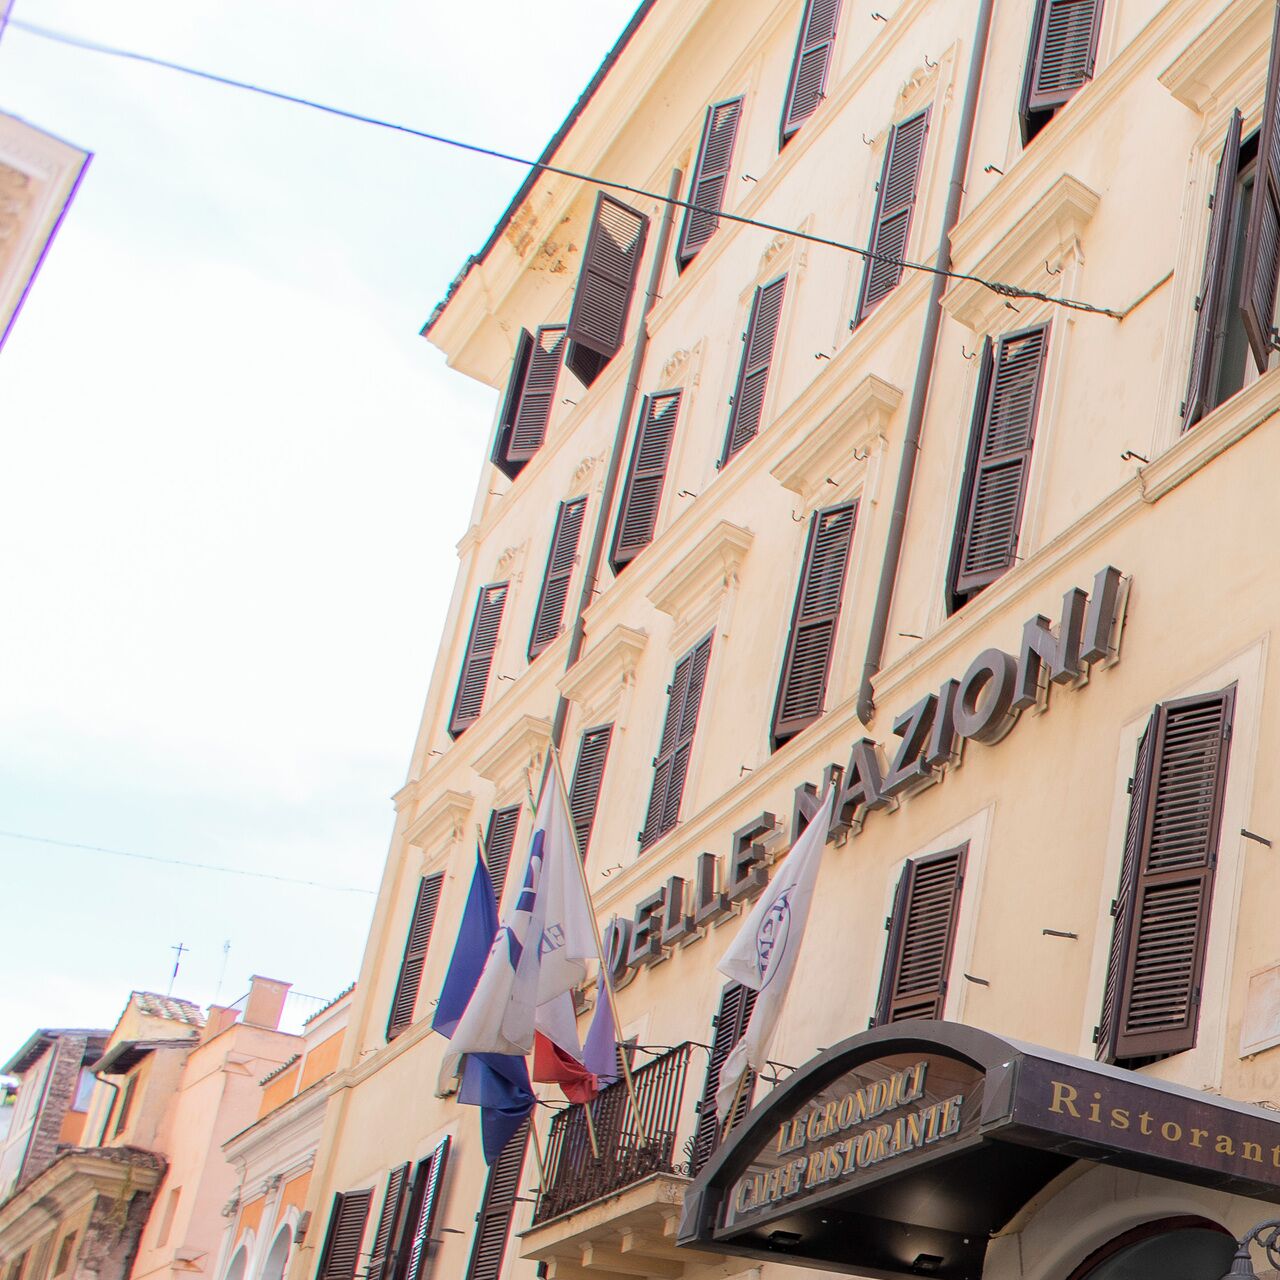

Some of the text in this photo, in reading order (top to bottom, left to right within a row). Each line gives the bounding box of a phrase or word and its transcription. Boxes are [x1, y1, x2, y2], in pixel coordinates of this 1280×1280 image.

[604, 565, 1123, 980] DELLE NAZIONI
[777, 1060, 929, 1157] LE GRONDICI
[804, 1094, 964, 1189] RISTORANTE
